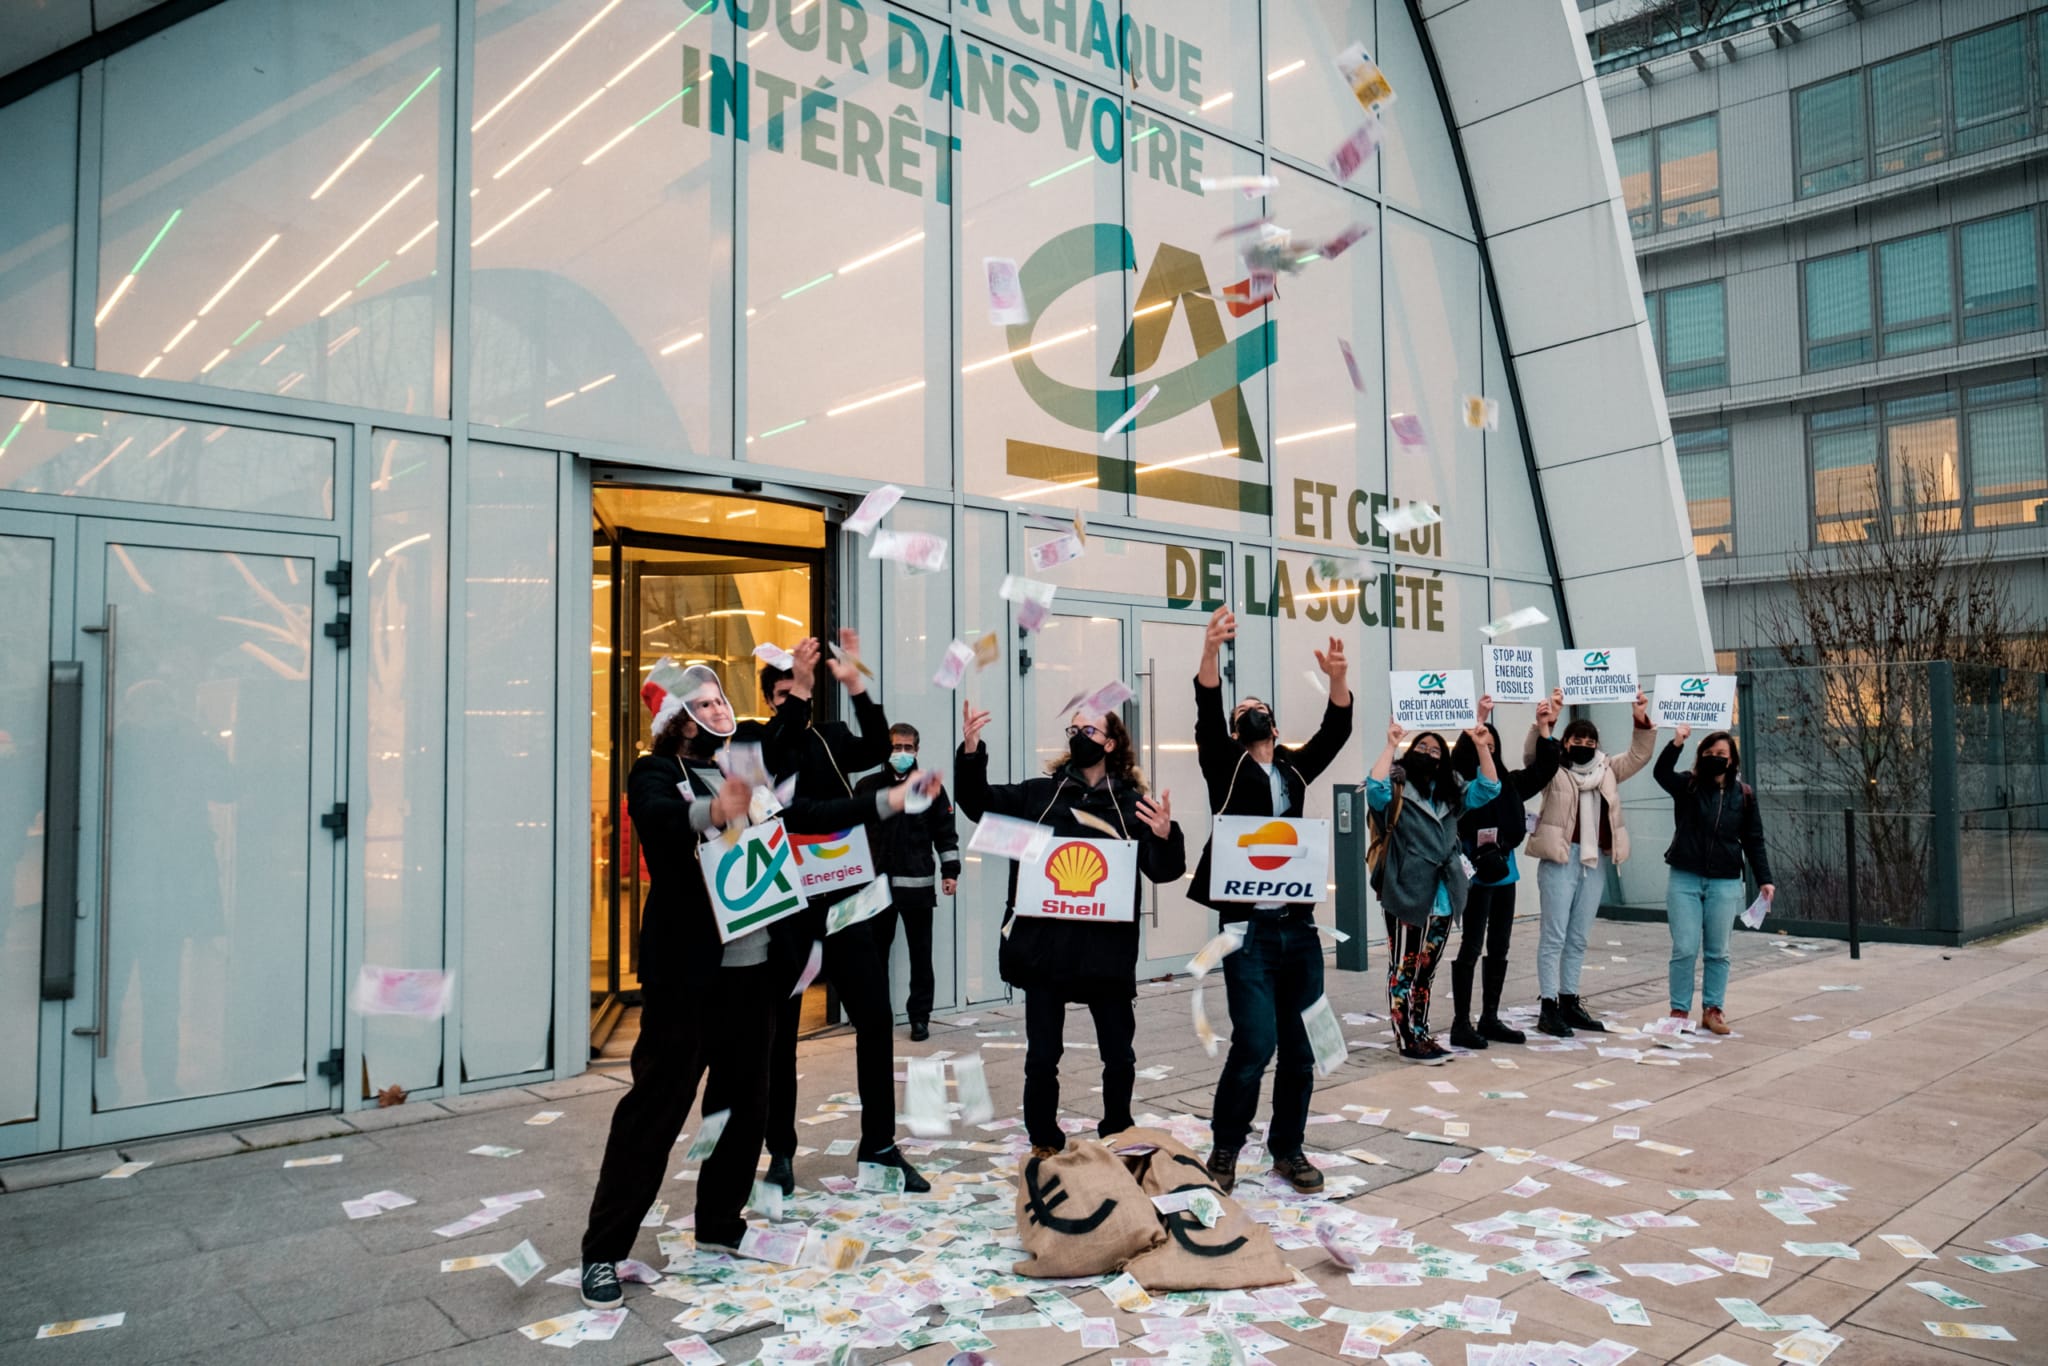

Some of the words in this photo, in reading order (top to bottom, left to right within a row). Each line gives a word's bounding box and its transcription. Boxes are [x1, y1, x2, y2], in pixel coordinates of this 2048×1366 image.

[887, 12, 1040, 134] DANS
[1054, 78, 1204, 197] VOTRE
[682, 44, 962, 206] INTÉRÊT
[1293, 477, 1338, 540] ET
[1165, 543, 1226, 612] DE
[1245, 555, 1297, 620] LA
[1305, 564, 1445, 632] SOCIÉTÉ
[1493, 648, 1515, 661] STOP
[1516, 649, 1533, 662] AUX
[1495, 661, 1533, 678] ÉNERGIES
[1565, 673, 1593, 686] CRÉDIT
[1595, 674, 1632, 684] AGRICOLE
[1496, 680, 1534, 695] FOSSILES
[1563, 686, 1580, 696] VOIT
[1581, 686, 1589, 695] LE
[1589, 685, 1609, 695] VERT
[1609, 685, 1619, 694] EN
[1619, 684, 1636, 693] NOIR
[1399, 696, 1429, 711] CRÉDIT
[1430, 698, 1469, 710] AGRICOLE
[1658, 699, 1687, 711] CRÉDIT
[1687, 701, 1727, 713] AGRICOLE
[1396, 710, 1414, 721] VOIT
[1415, 710, 1424, 721] LE
[1425, 710, 1444, 720] VERT
[1445, 709, 1456, 720] EN
[1456, 709, 1474, 720] NOIR
[1663, 711, 1685, 721] NOUS
[1686, 711, 1719, 722] ENFUME
[1223, 880, 1314, 898] REPSOL
[1041, 899, 1106, 917] Shell
